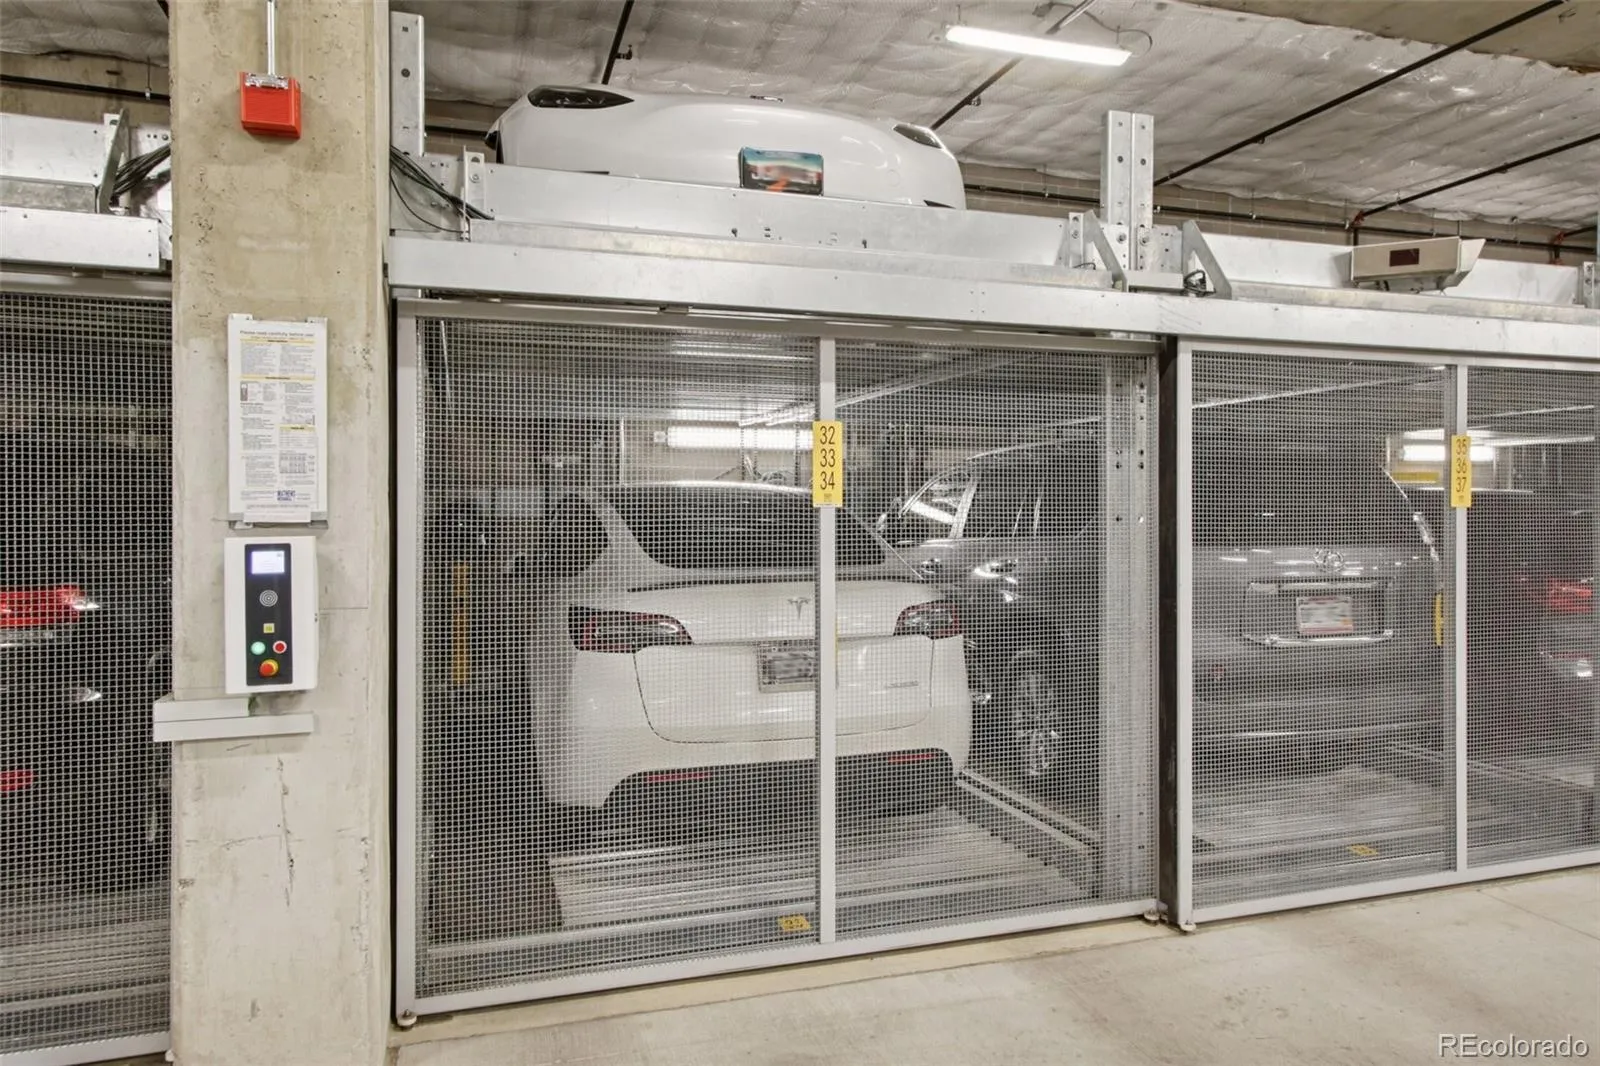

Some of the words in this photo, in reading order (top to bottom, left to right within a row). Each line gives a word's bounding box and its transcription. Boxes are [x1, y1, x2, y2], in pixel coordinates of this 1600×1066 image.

[819, 425, 836, 445] 32
[1456, 438, 1467, 455] 35
[819, 448, 836, 468] 33
[1456, 457, 1467, 474] 36
[819, 471, 836, 490] 34
[1456, 476, 1467, 493] 37
